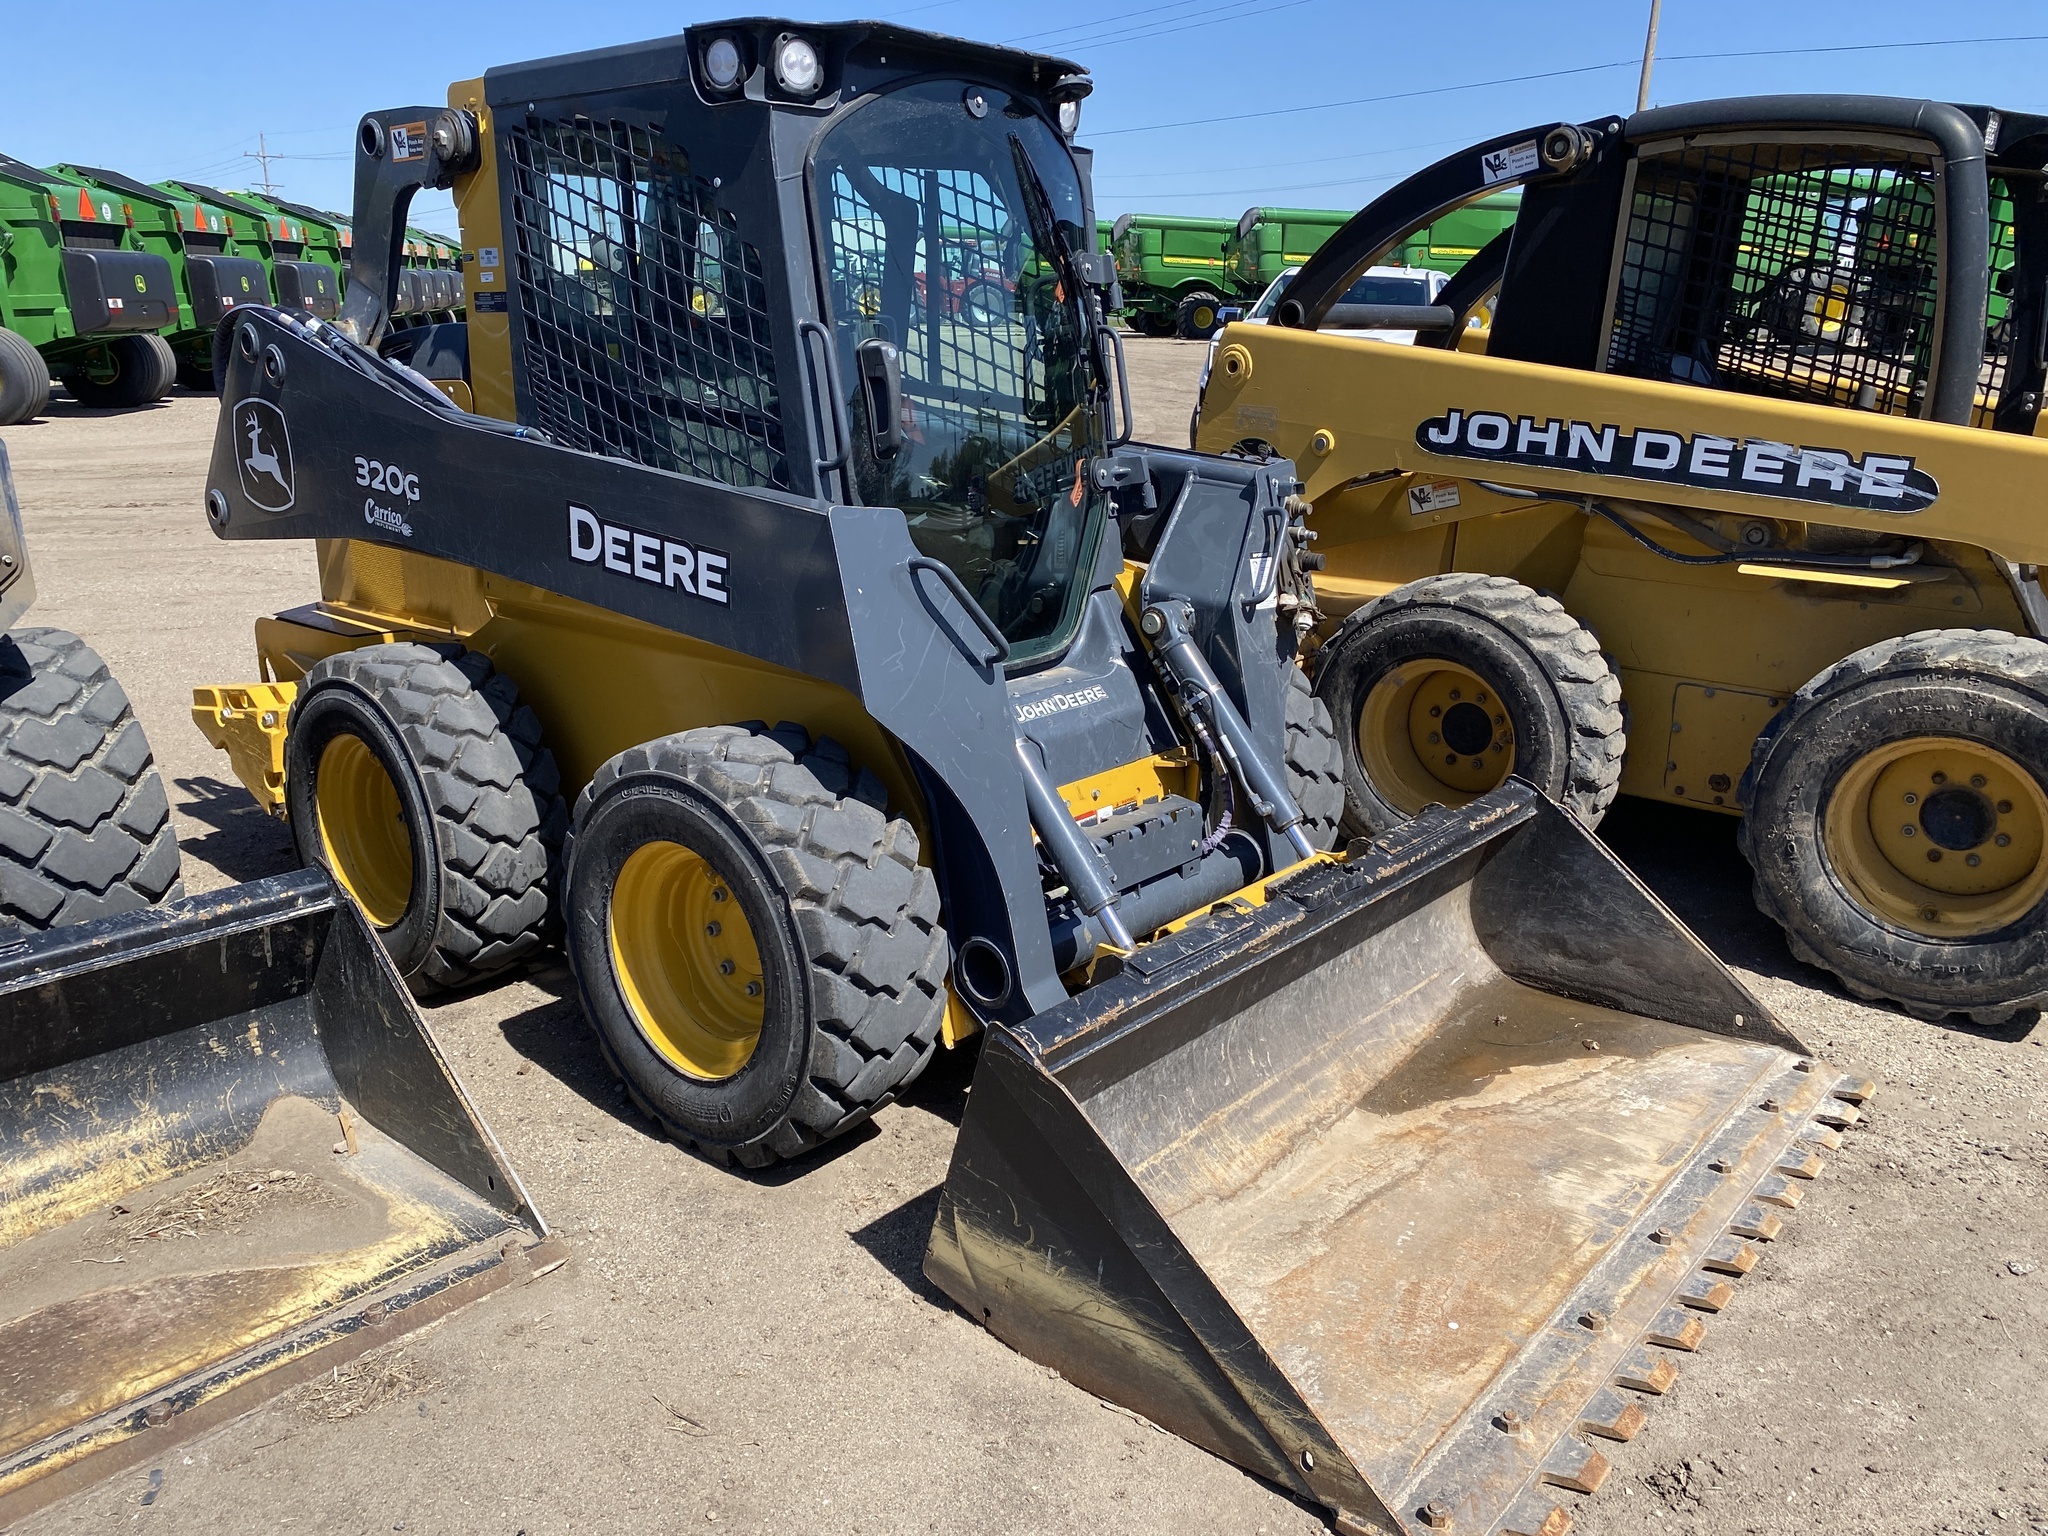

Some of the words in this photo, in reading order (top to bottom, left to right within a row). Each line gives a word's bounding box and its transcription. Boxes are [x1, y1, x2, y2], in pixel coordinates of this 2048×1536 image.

[1427, 411, 1616, 463] JOHN
[1633, 430, 1910, 499] DEERE
[354, 456, 420, 501] 320G
[364, 497, 402, 526] Carrico
[374, 520, 401, 534] IMPLEMENT
[568, 504, 729, 604] DEERE
[1014, 695, 1056, 723] JOHN
[1056, 684, 1107, 711] DEERE
[349, 692, 407, 762] GALAXY
[621, 784, 710, 815] GALAXY
